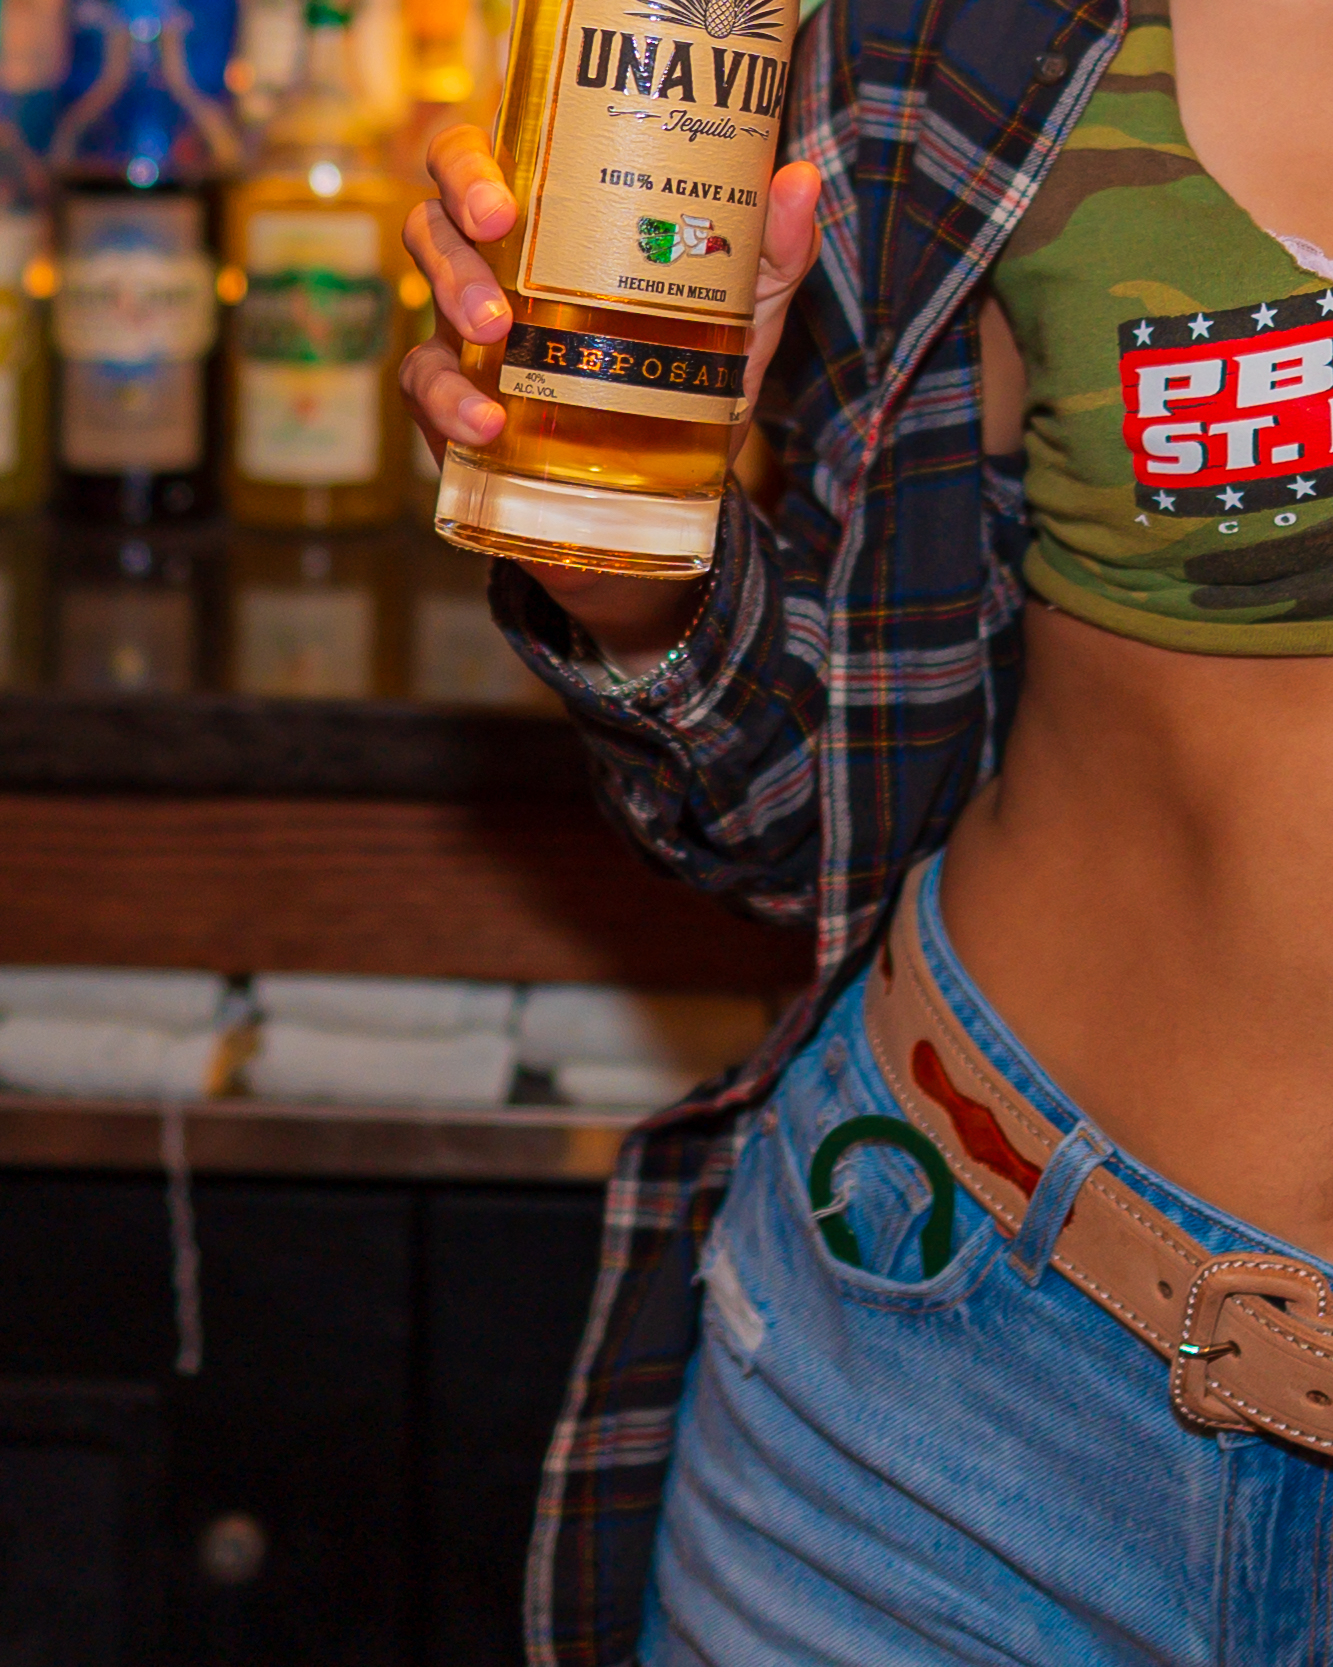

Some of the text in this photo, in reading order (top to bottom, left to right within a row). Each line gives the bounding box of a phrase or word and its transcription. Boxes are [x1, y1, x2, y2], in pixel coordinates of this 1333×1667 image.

[576, 26, 697, 103] UNA
[661, 109, 737, 142] Tequila
[599, 167, 758, 207] 100% AGAVE AZUL
[617, 275, 727, 303] HECHO EN MEXICO
[513, 382, 558, 400] ALC. VOL
[525, 372, 546, 385] 40%
[1142, 415, 1305, 475] ST.
